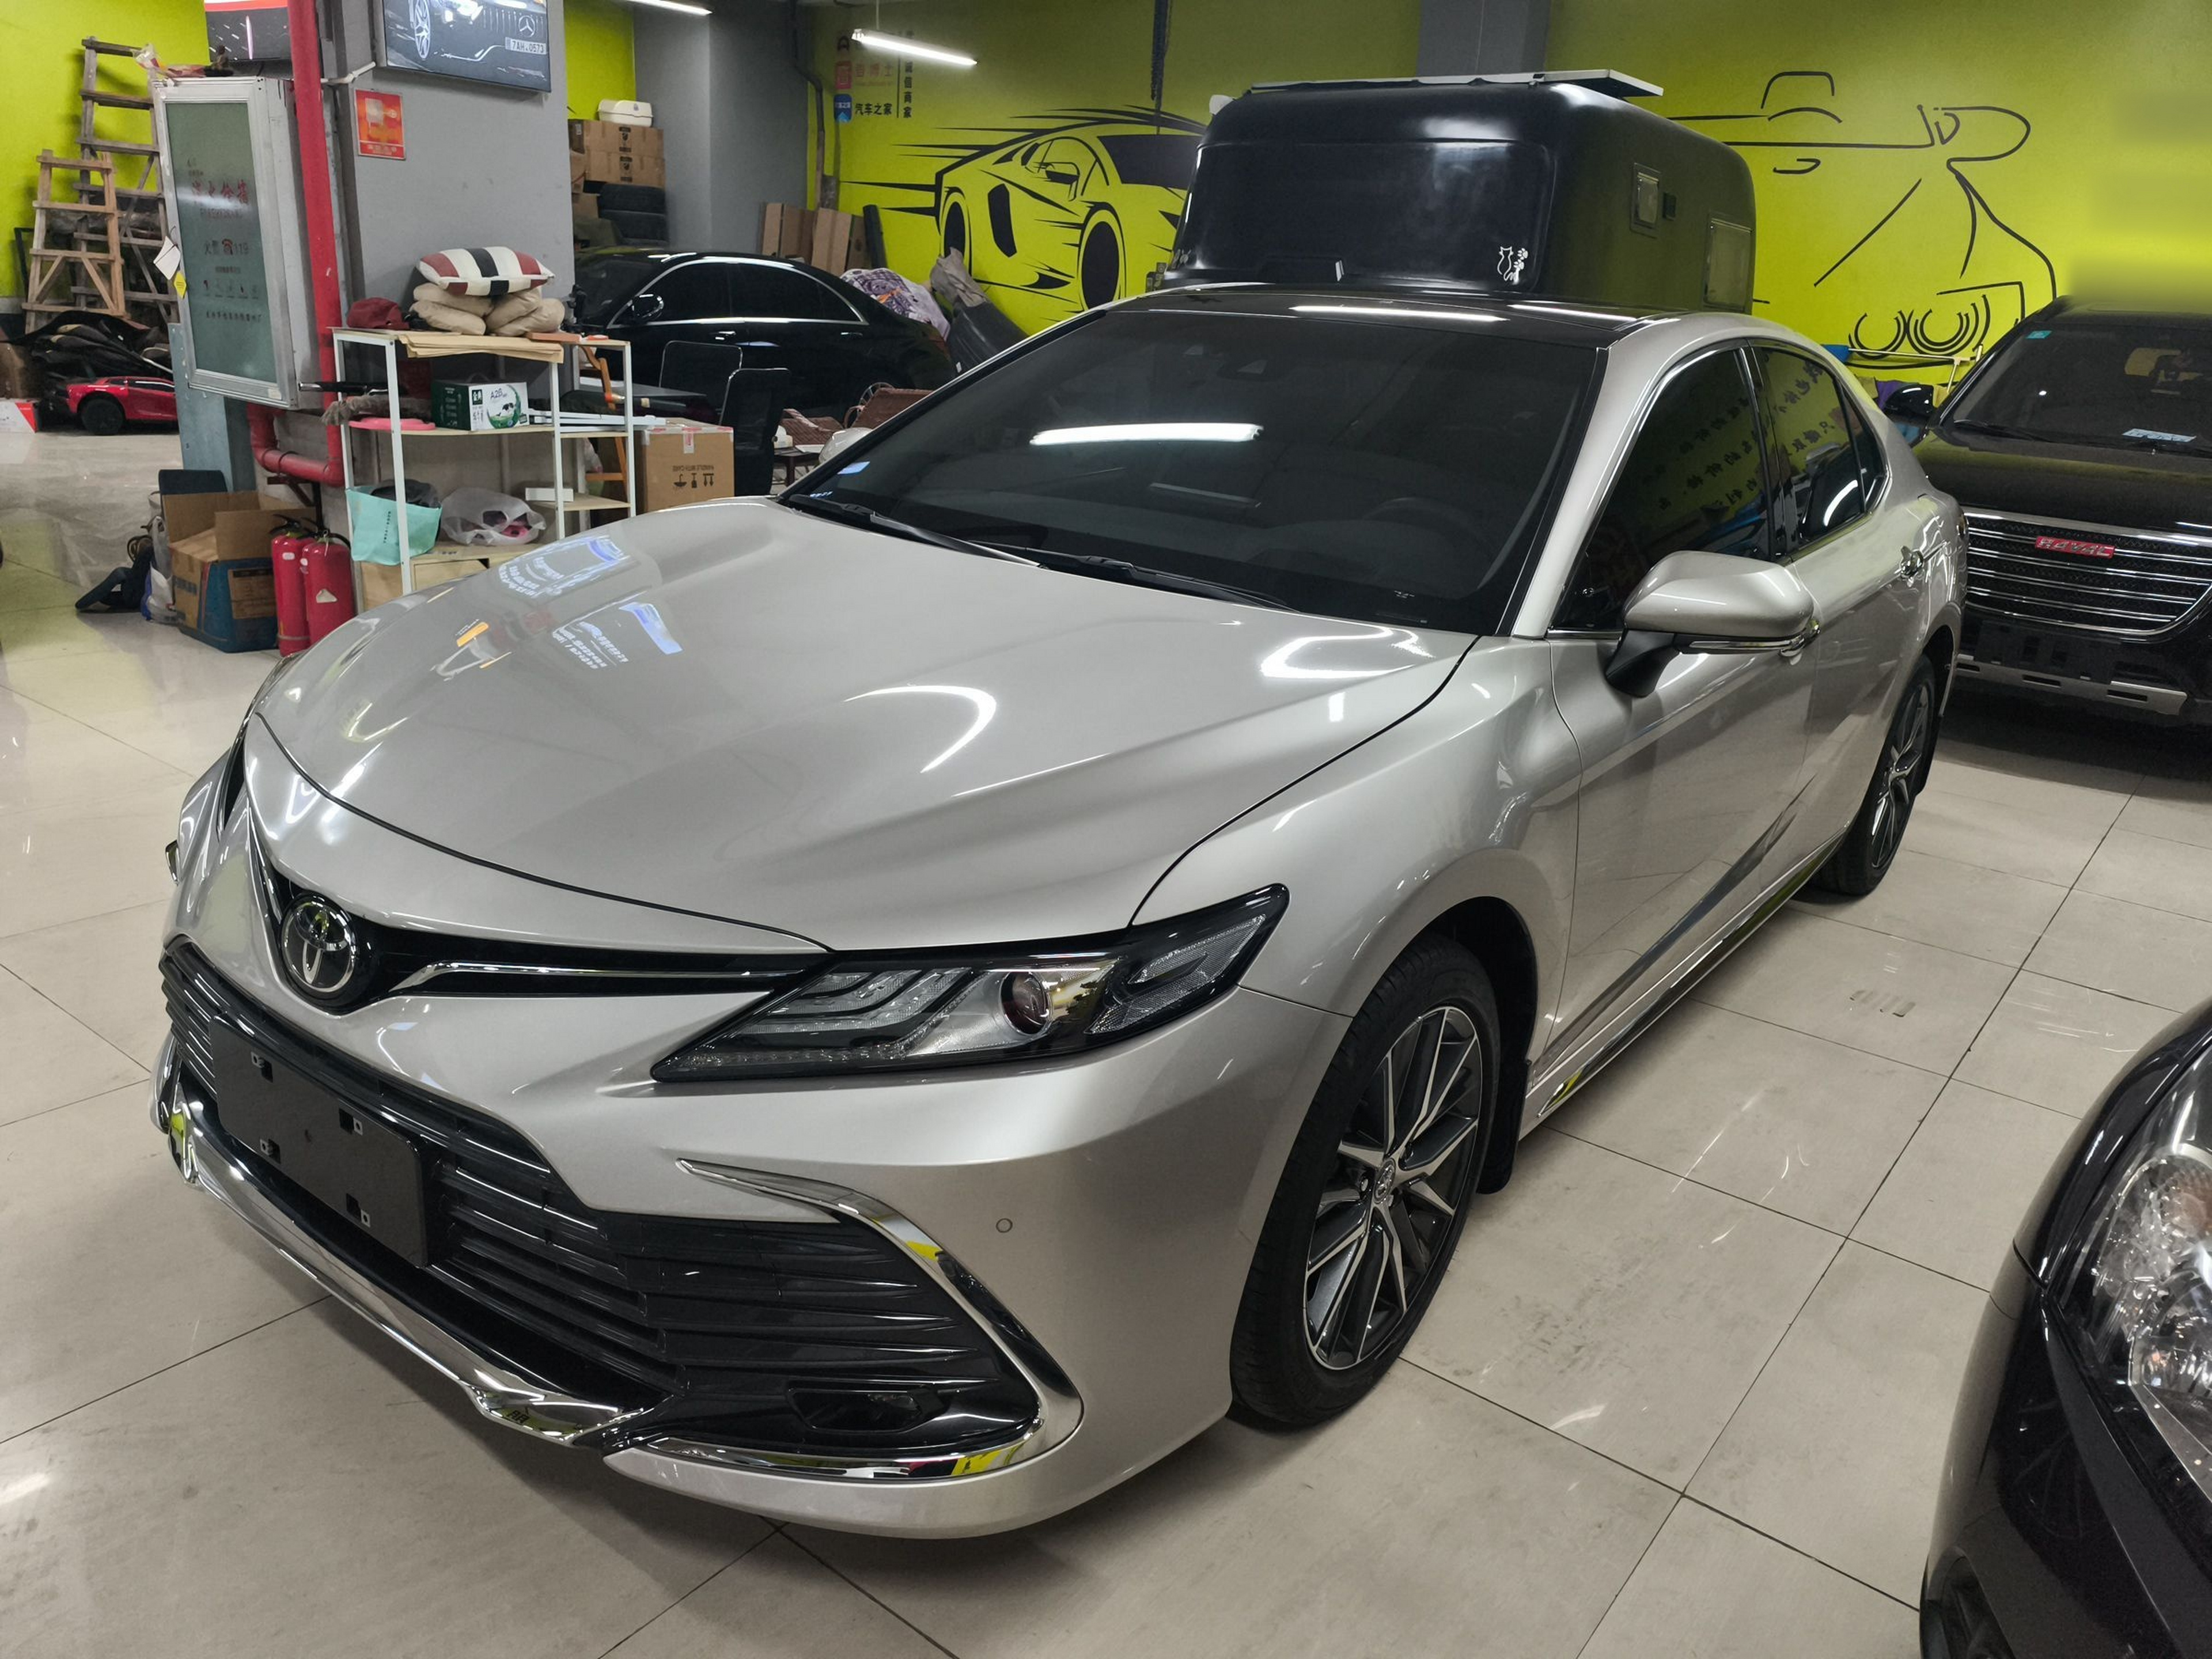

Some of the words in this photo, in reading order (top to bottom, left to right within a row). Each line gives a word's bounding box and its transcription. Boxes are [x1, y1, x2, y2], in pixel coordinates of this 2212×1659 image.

[855, 103, 892, 116] 汽车之家
[2038, 537, 2115, 557] HAVAL
